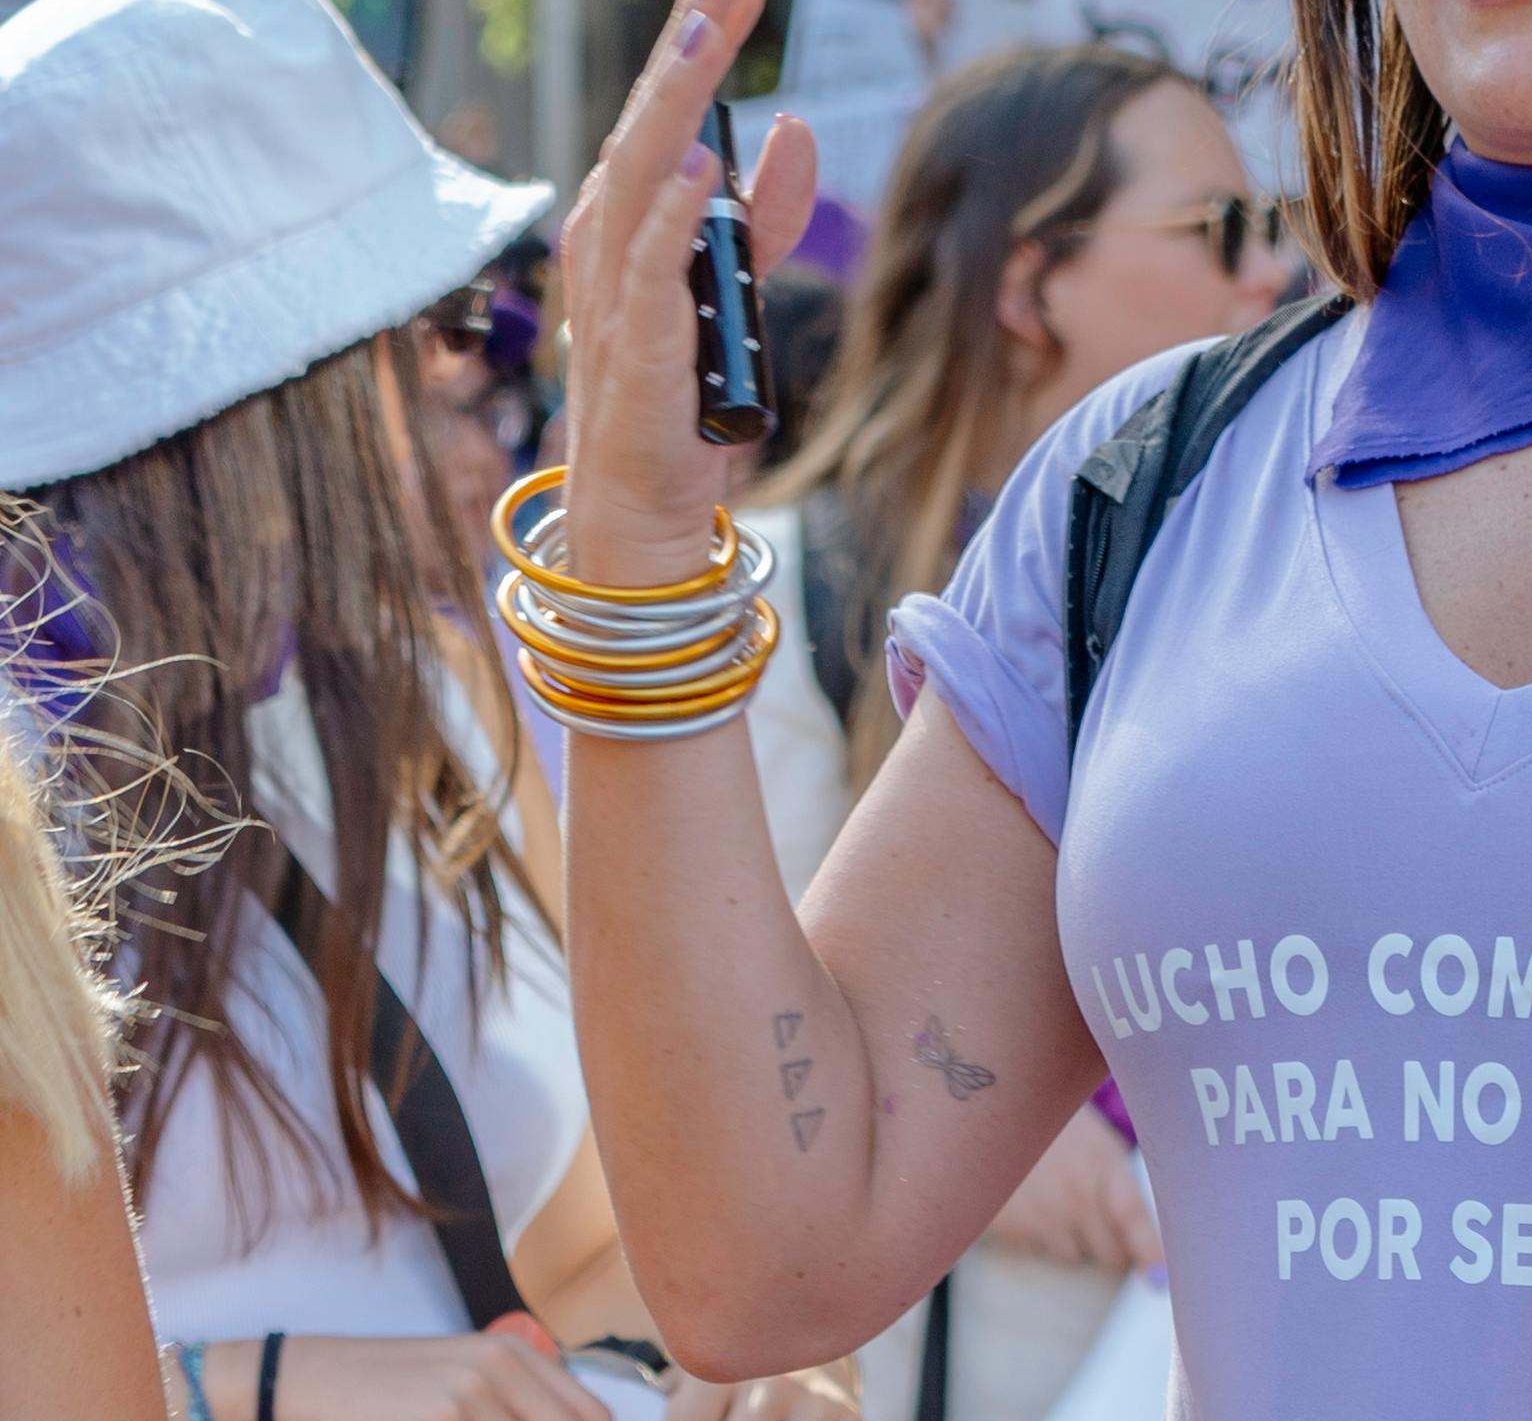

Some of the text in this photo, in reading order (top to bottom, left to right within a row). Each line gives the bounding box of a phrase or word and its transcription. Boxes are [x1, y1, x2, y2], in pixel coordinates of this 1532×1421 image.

[1091, 934, 1329, 1040] LUCHO
[1190, 1059, 1373, 1146] PARA
[1403, 1060, 1522, 1146] NO
[1276, 1197, 1421, 1282] POR
